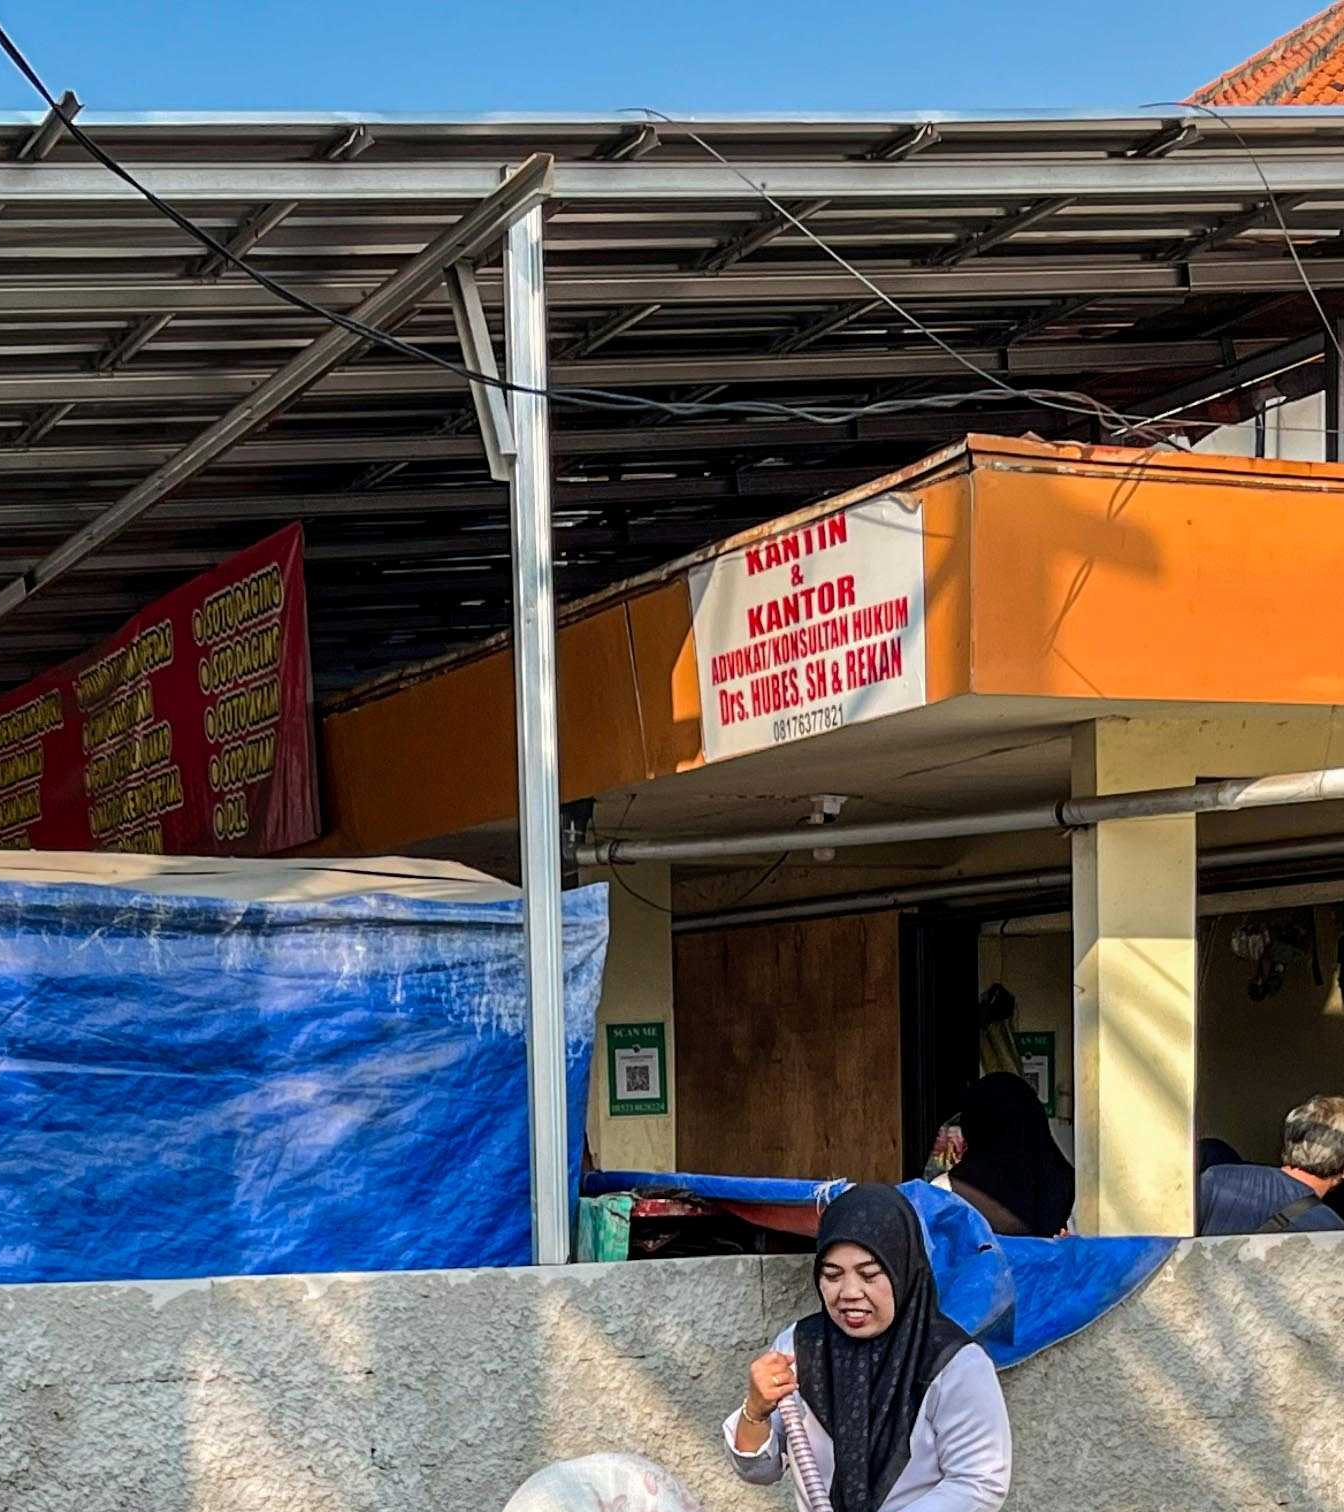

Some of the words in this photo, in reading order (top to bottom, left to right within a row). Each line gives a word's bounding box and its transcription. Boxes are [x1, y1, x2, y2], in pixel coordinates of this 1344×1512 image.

[234, 566, 280, 624] DAGING
[791, 564, 804, 586] &
[747, 575, 856, 638] KANTOR
[235, 623, 279, 678] DAGING
[711, 614, 848, 686] ADVOKAT/KONSULTAN
[852, 596, 909, 643] HUKUM
[718, 690, 749, 726] Drs.
[751, 667, 803, 717] HUBES,
[806, 659, 827, 701] SH
[831, 662, 843, 694] &
[846, 636, 902, 690] REKAN
[216, 693, 248, 740] SOTO
